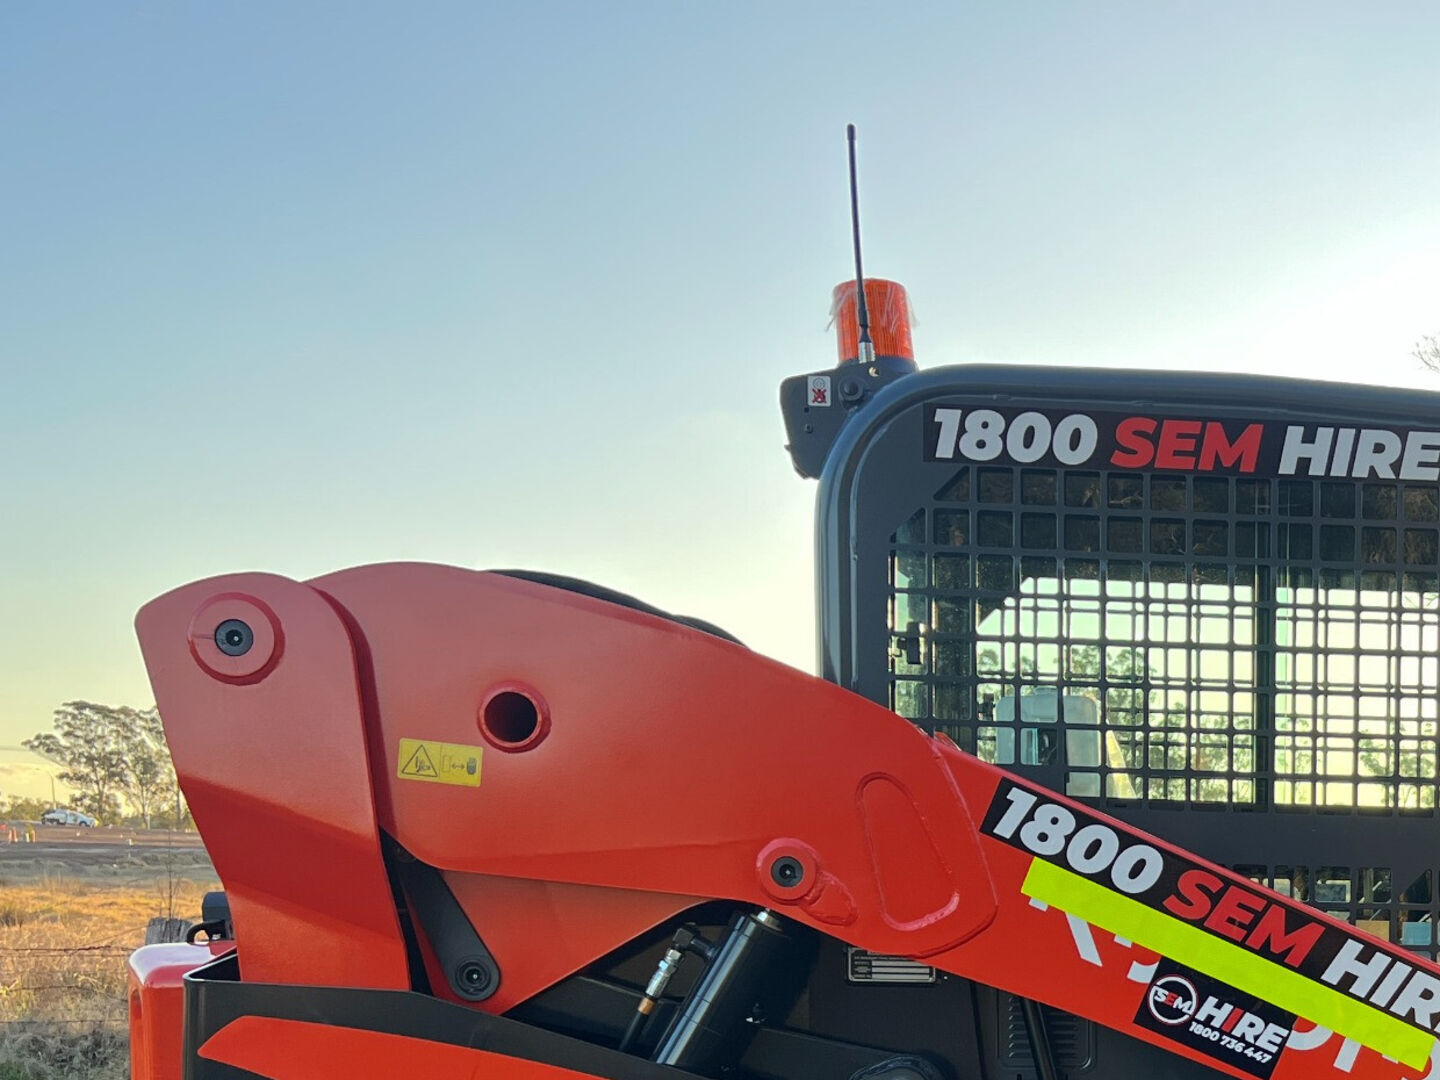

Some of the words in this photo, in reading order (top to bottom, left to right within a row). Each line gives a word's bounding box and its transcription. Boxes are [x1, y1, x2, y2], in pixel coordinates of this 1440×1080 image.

[933, 409, 1098, 465] 1800
[1110, 417, 1264, 473] SEM
[993, 787, 1164, 894] 1800
[1163, 870, 1326, 968] SEM
[1189, 1021, 1220, 1043] 1800
[1221, 1034, 1246, 1053] 736
[1244, 1047, 1273, 1065] 447
[1195, 996, 1290, 1053] HIRE
